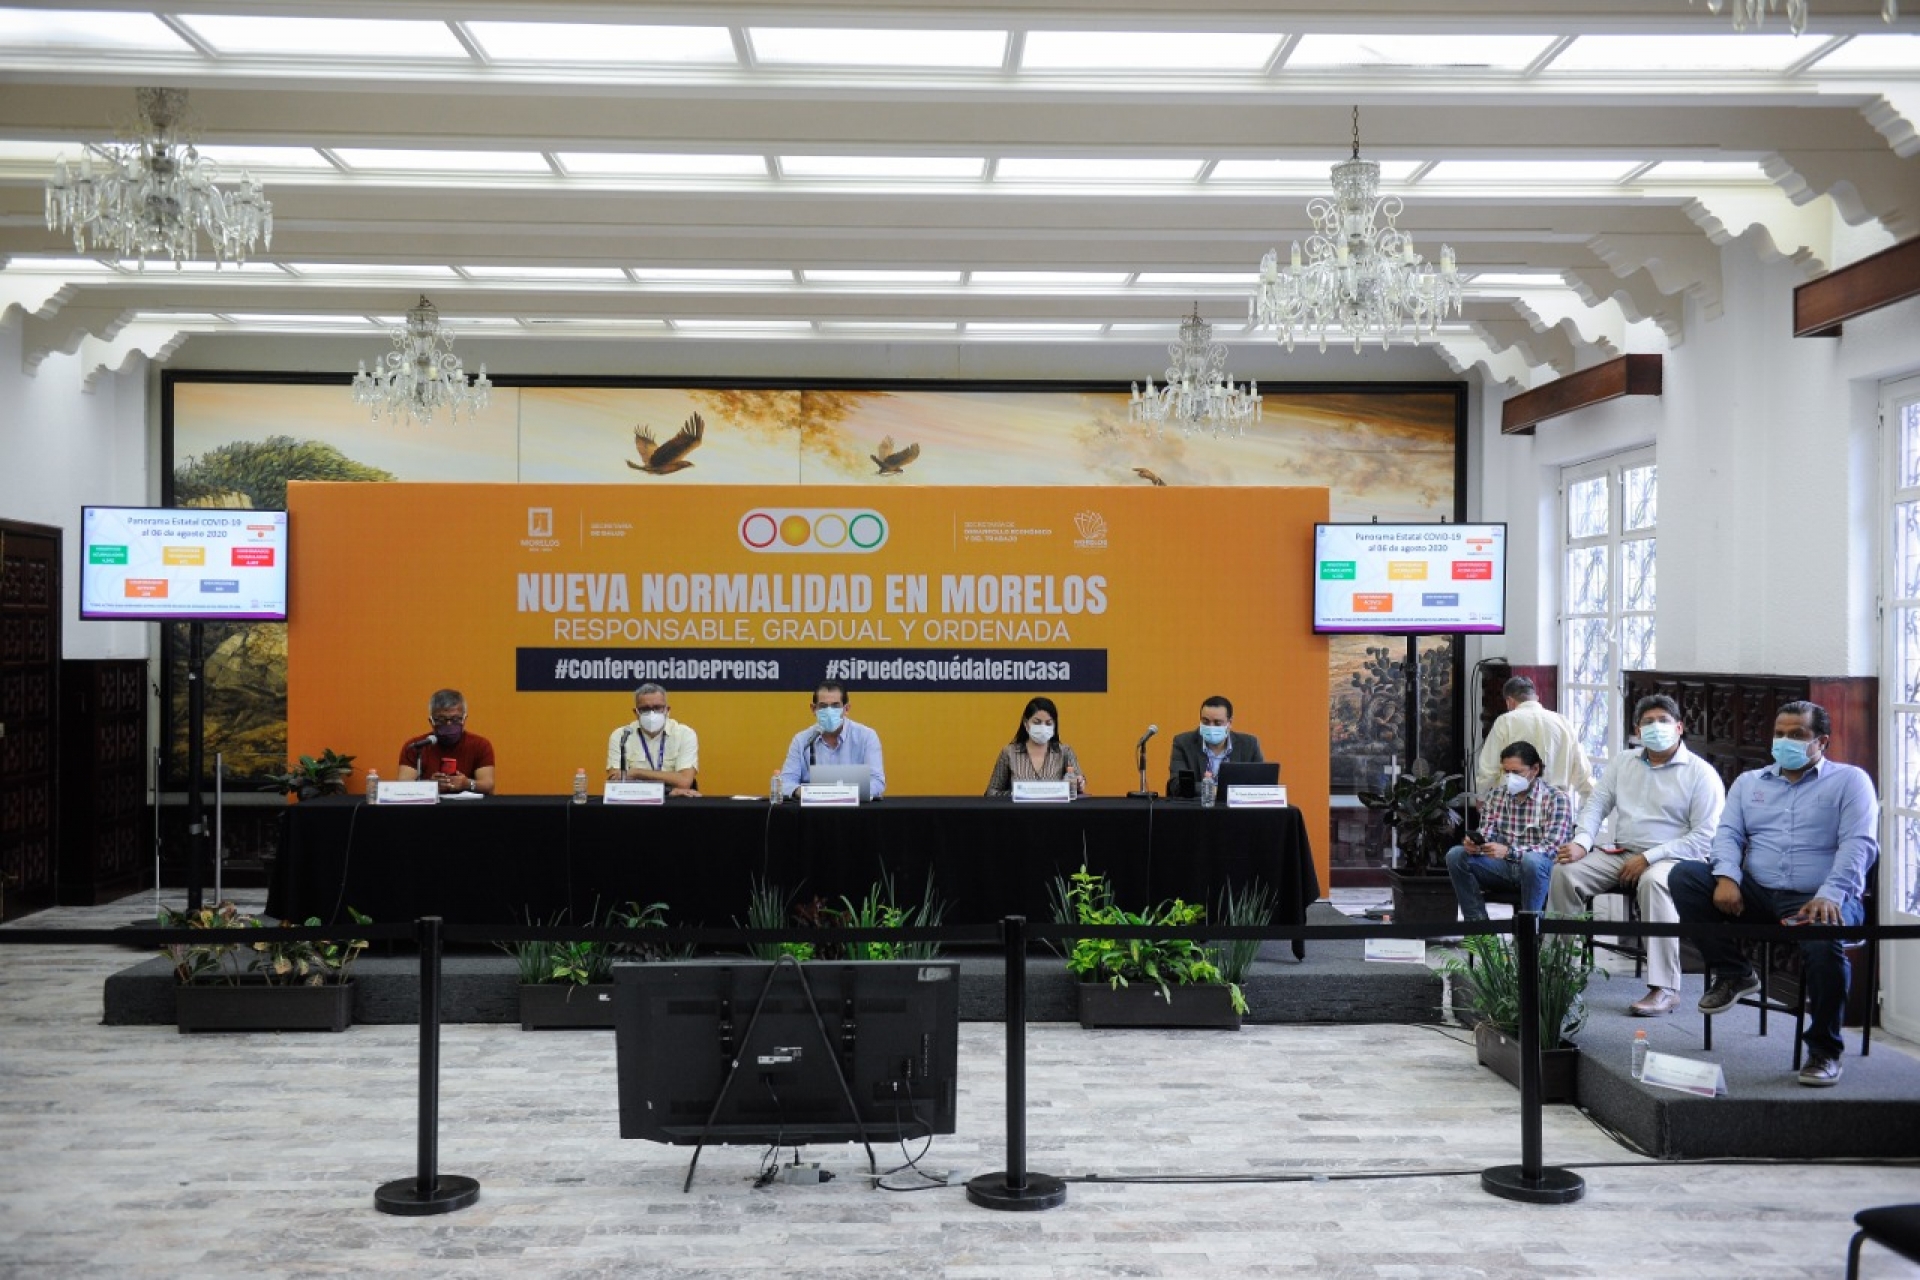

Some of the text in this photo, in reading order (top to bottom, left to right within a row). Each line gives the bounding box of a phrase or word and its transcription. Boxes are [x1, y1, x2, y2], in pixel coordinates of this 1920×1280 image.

[127, 517, 242, 527] Panorama Estatal COVID-19
[142, 529, 150, 537] al
[163, 529, 175, 537] de
[177, 530, 205, 539] agosto
[206, 530, 228, 538] 2020
[1355, 532, 1395, 541] Panorama
[1396, 532, 1422, 541] Estatal
[1423, 532, 1462, 541] COVID-19
[1368, 544, 1376, 552] al
[1389, 544, 1399, 552] de
[1400, 545, 1427, 553] agosto
[517, 573, 1108, 614] NUEVA NORMALIDAD EN MORELOS
[554, 618, 1071, 644] RESPONSABLE, GRADUAL Y ORDENADA
[554, 655, 1071, 681] #ConferenciaDePrensa #SiPuedesQuédateEnCasa
